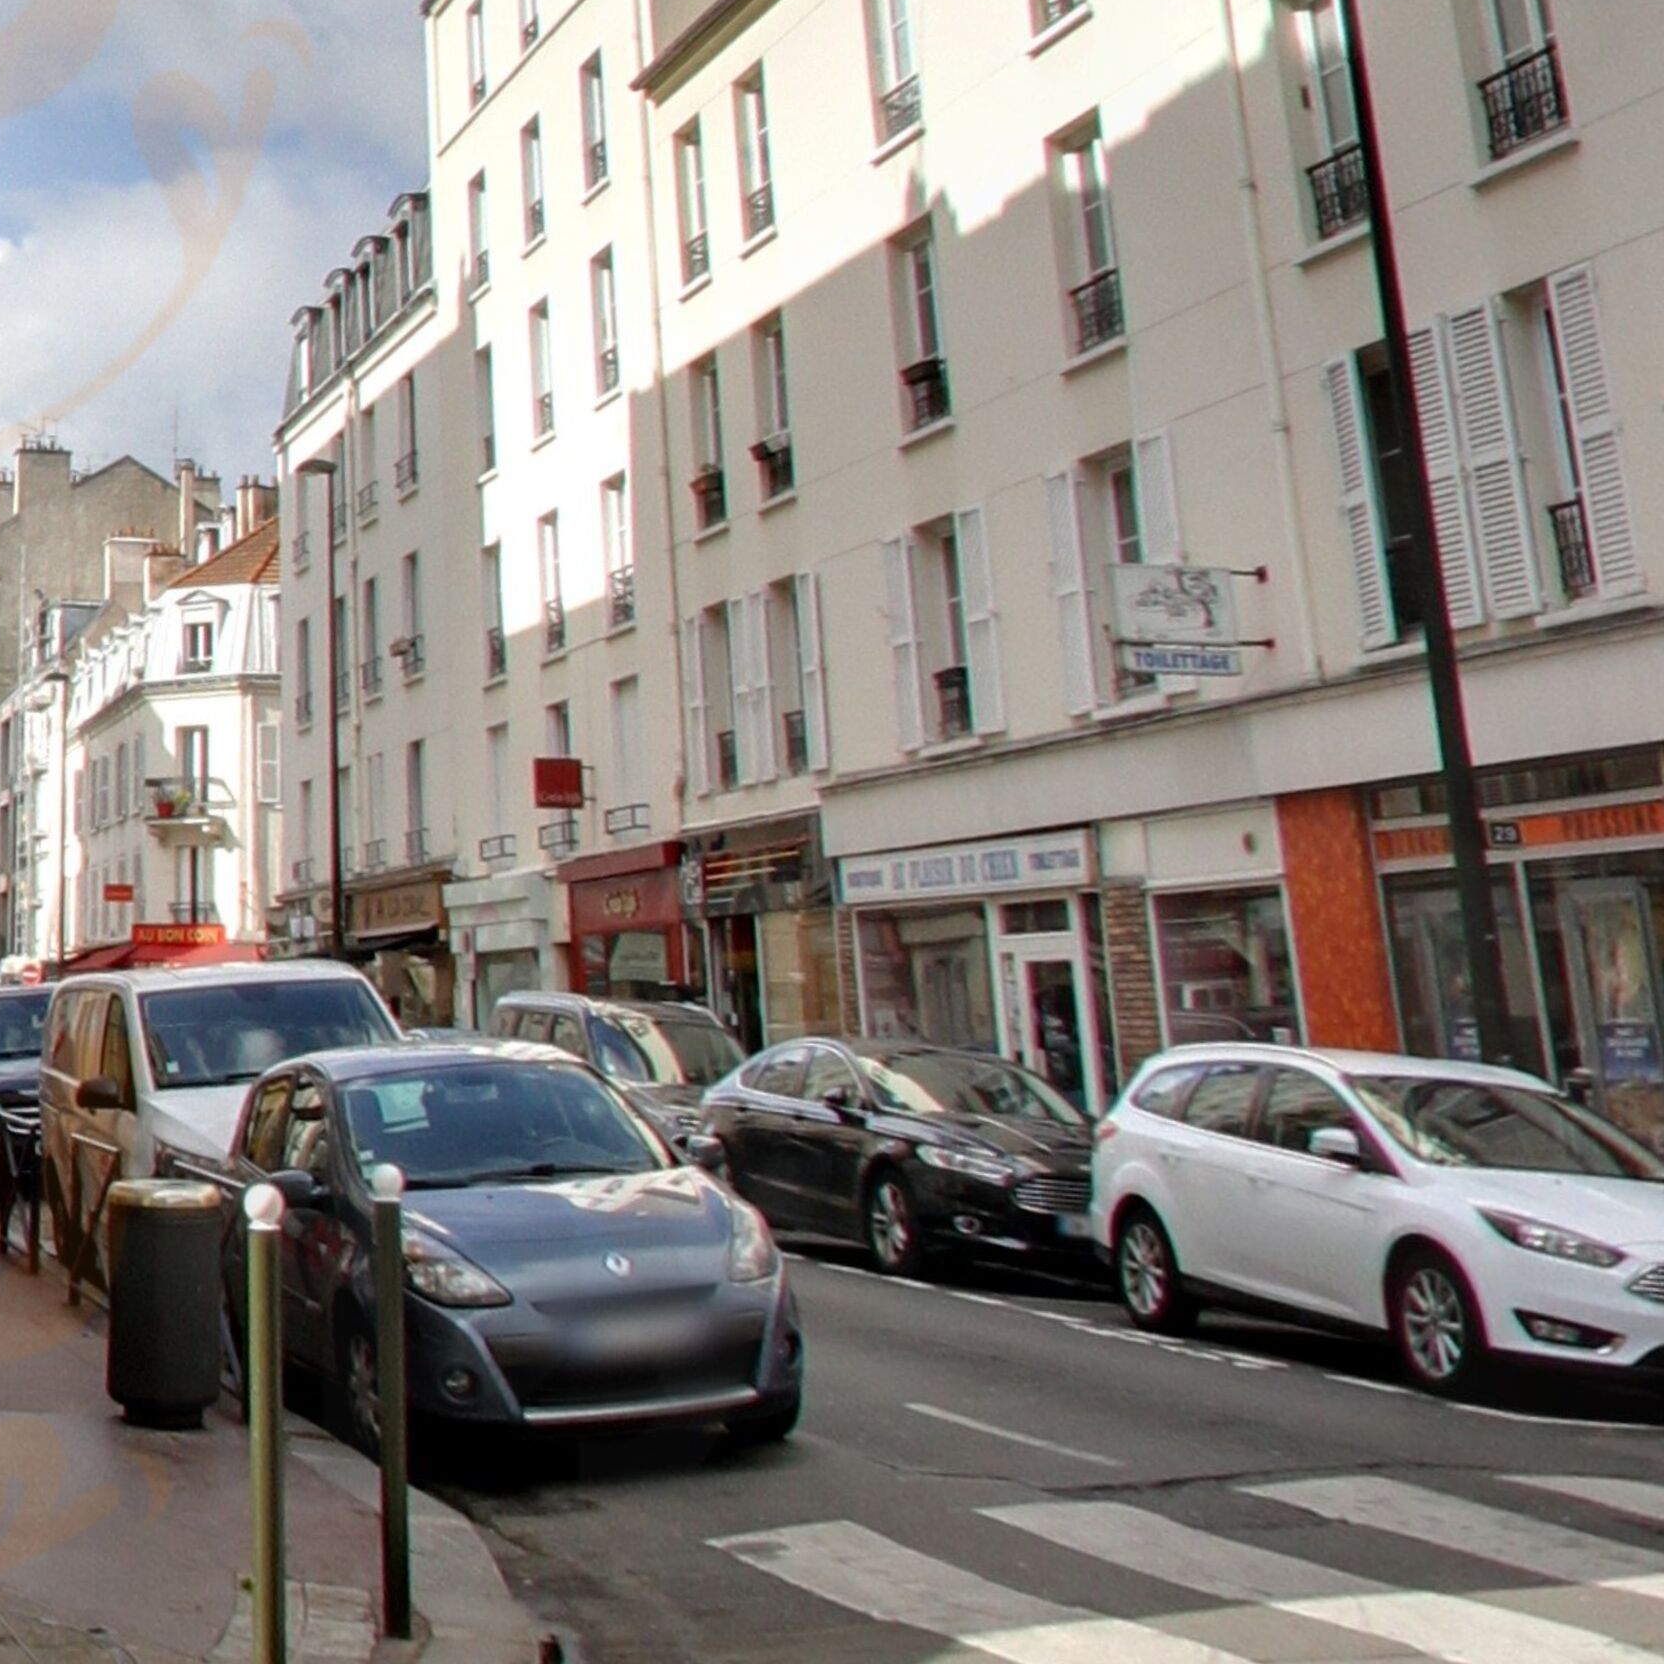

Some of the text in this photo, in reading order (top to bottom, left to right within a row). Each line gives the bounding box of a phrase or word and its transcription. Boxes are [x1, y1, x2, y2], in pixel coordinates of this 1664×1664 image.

[1133, 651, 1232, 670] TOILETTAGE
[1493, 825, 1517, 842] 29
[158, 927, 184, 941] BON
[187, 926, 220, 942] COIN
